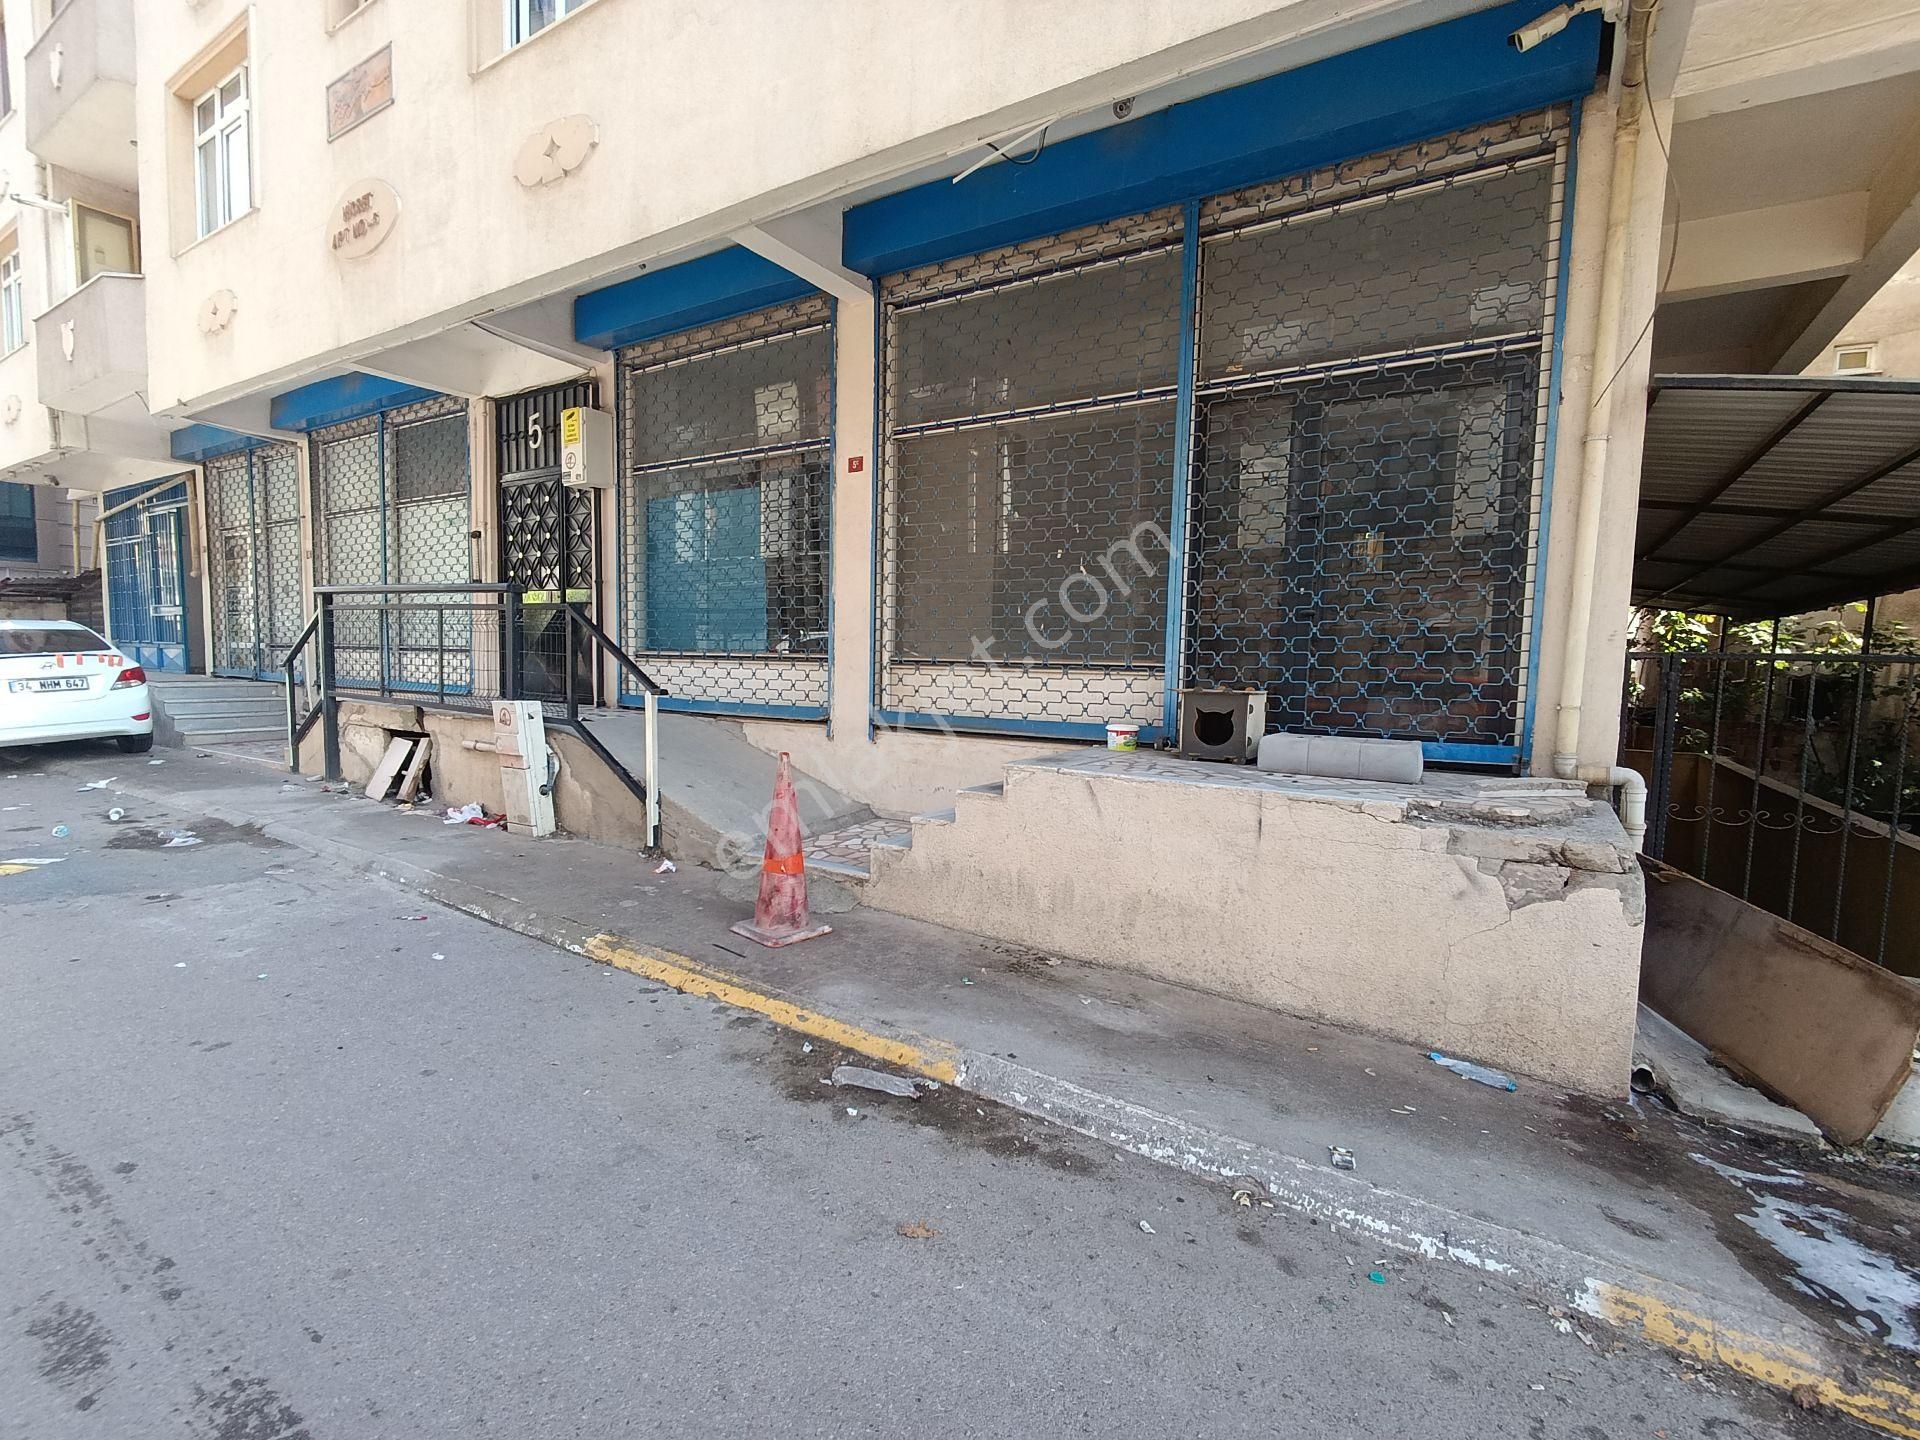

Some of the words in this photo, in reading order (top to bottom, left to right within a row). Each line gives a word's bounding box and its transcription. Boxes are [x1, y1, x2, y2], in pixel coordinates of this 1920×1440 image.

[528, 412, 542, 449] 5
[18, 682, 32, 691] 34
[40, 680, 61, 690] NHM
[65, 679, 85, 688] 647
